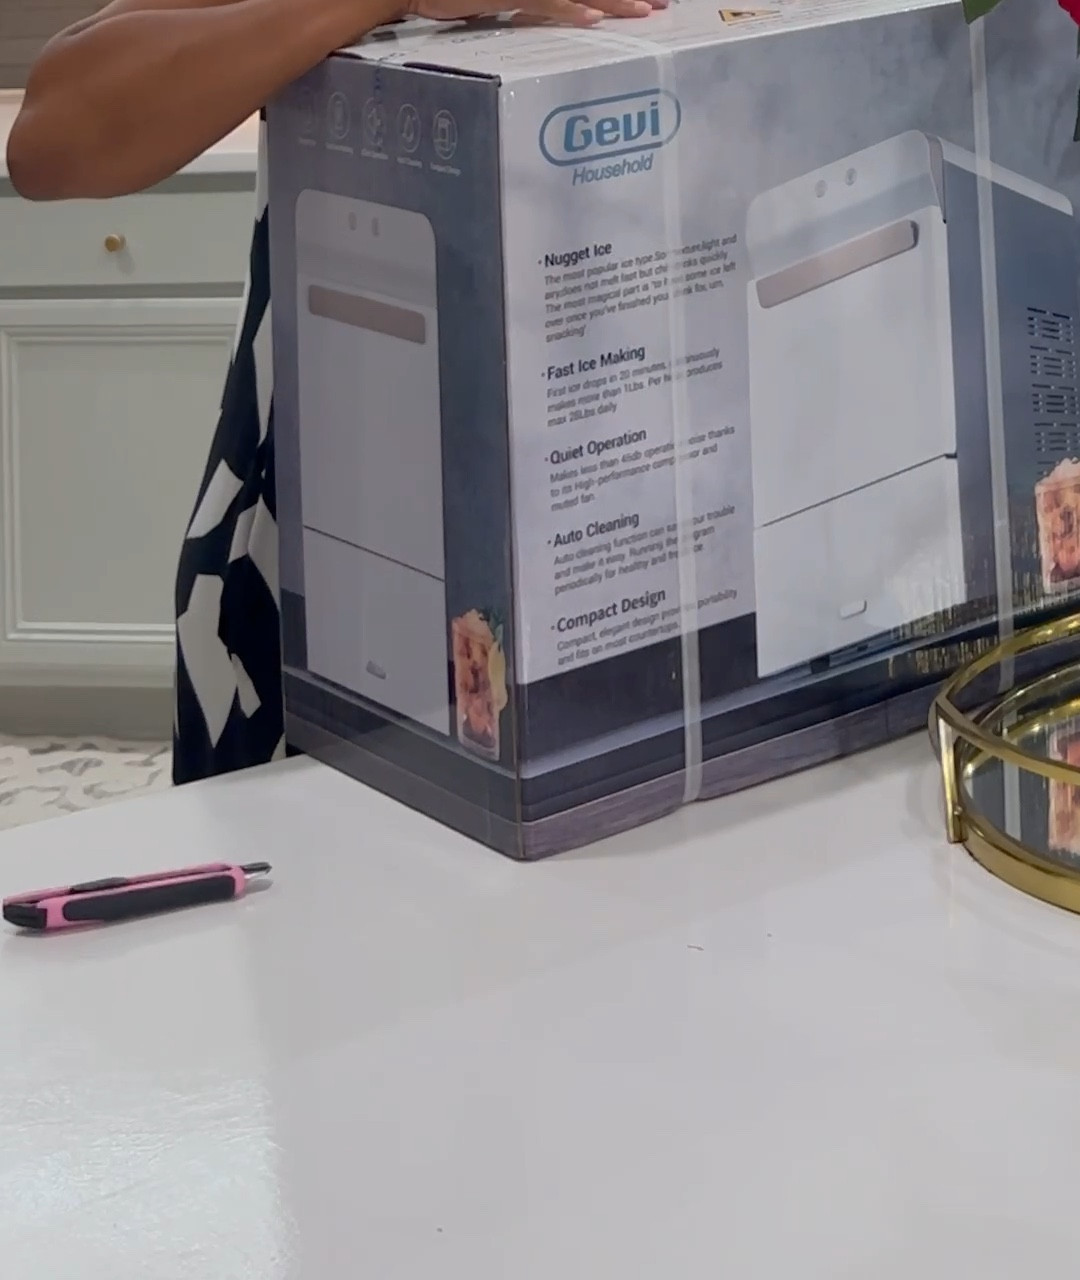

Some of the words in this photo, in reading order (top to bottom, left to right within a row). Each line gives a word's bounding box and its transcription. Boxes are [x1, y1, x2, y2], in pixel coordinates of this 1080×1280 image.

[563, 102, 660, 152] Gevi
[572, 153, 654, 186] Household
[545, 247, 590, 268] Nugget
[594, 243, 611, 257] Ice
[547, 362, 574, 381] Fast
[578, 359, 596, 373] Ice
[600, 347, 645, 367] Making
[550, 444, 583, 465] Quiet
[587, 430, 646, 456] Operation
[553, 530, 583, 548] Auto
[586, 513, 639, 537] Cleaning
[557, 603, 617, 633] Compact
[621, 590, 665, 613] Design
